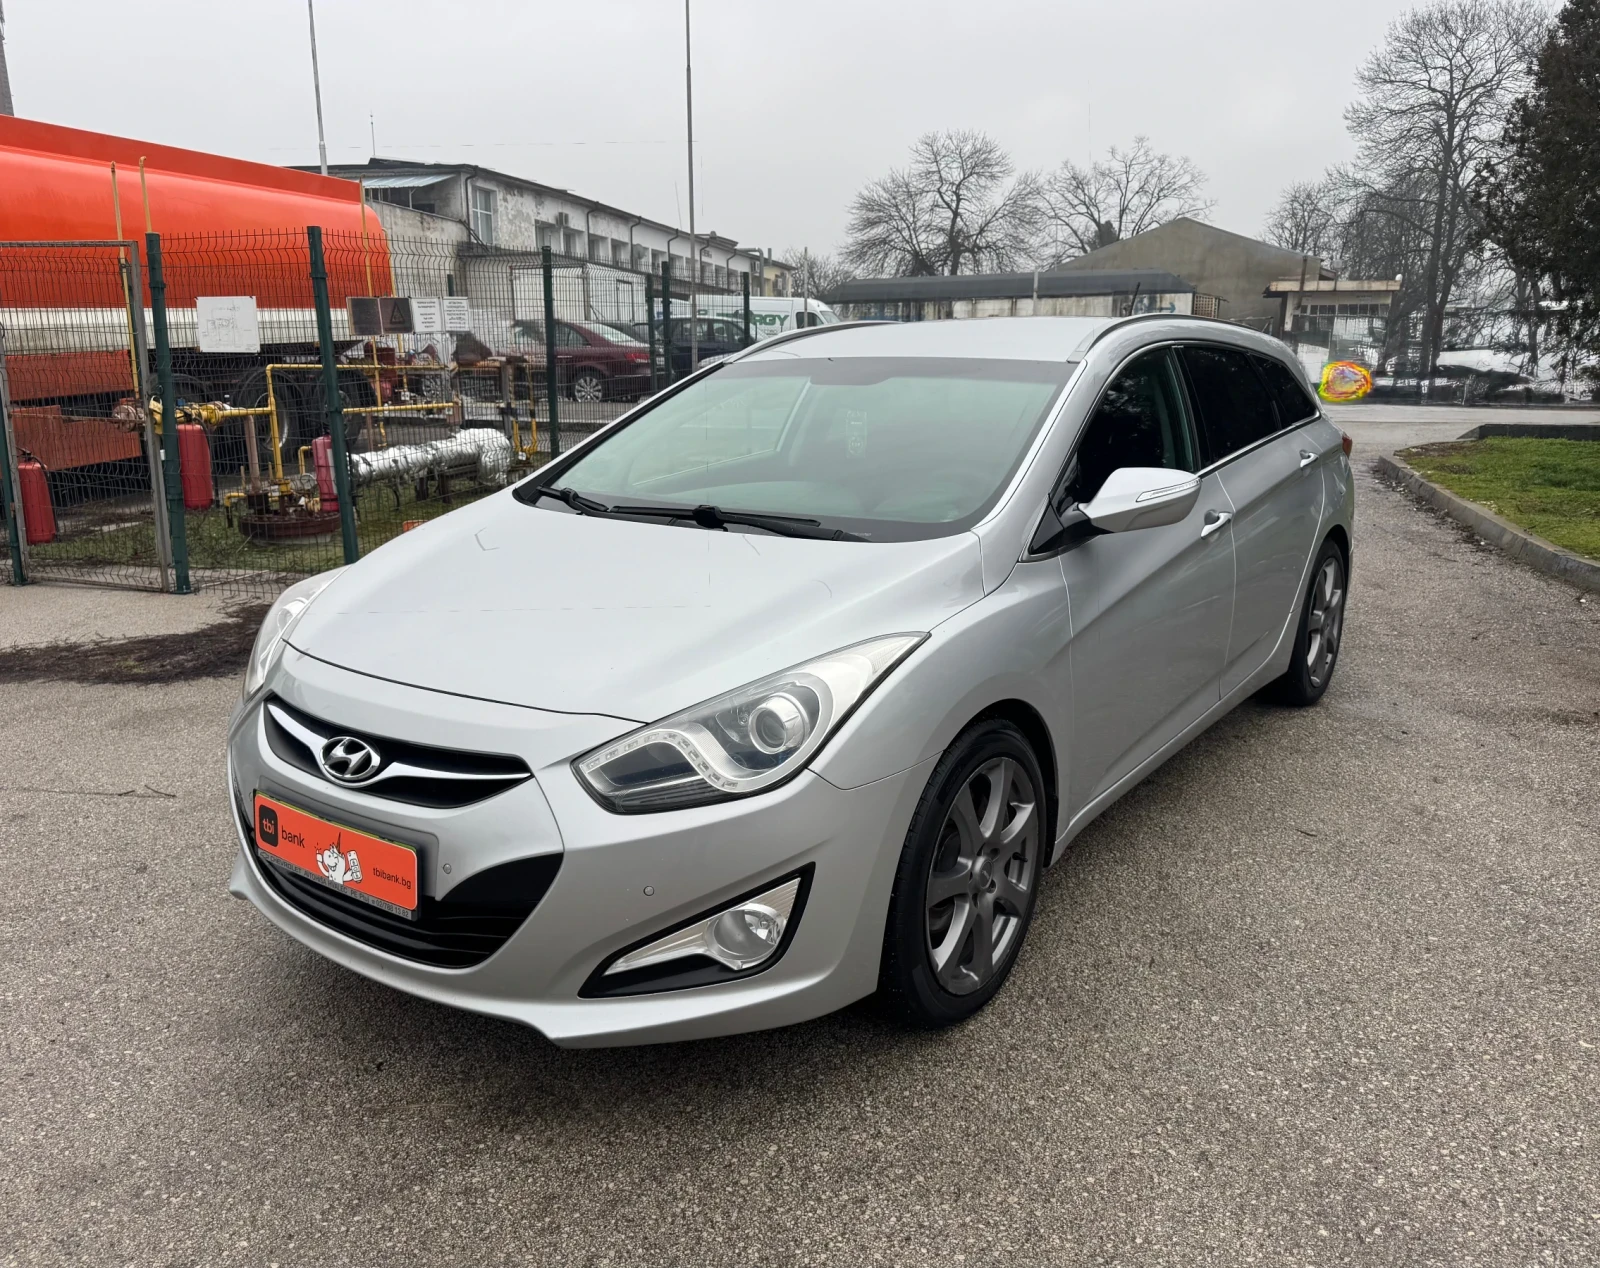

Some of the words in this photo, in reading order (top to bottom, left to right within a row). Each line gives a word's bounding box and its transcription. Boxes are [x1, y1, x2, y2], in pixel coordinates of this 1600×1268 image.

[263, 818, 275, 835] tbi
[281, 825, 305, 848] bank
[373, 868, 411, 889] tbibank.bg
